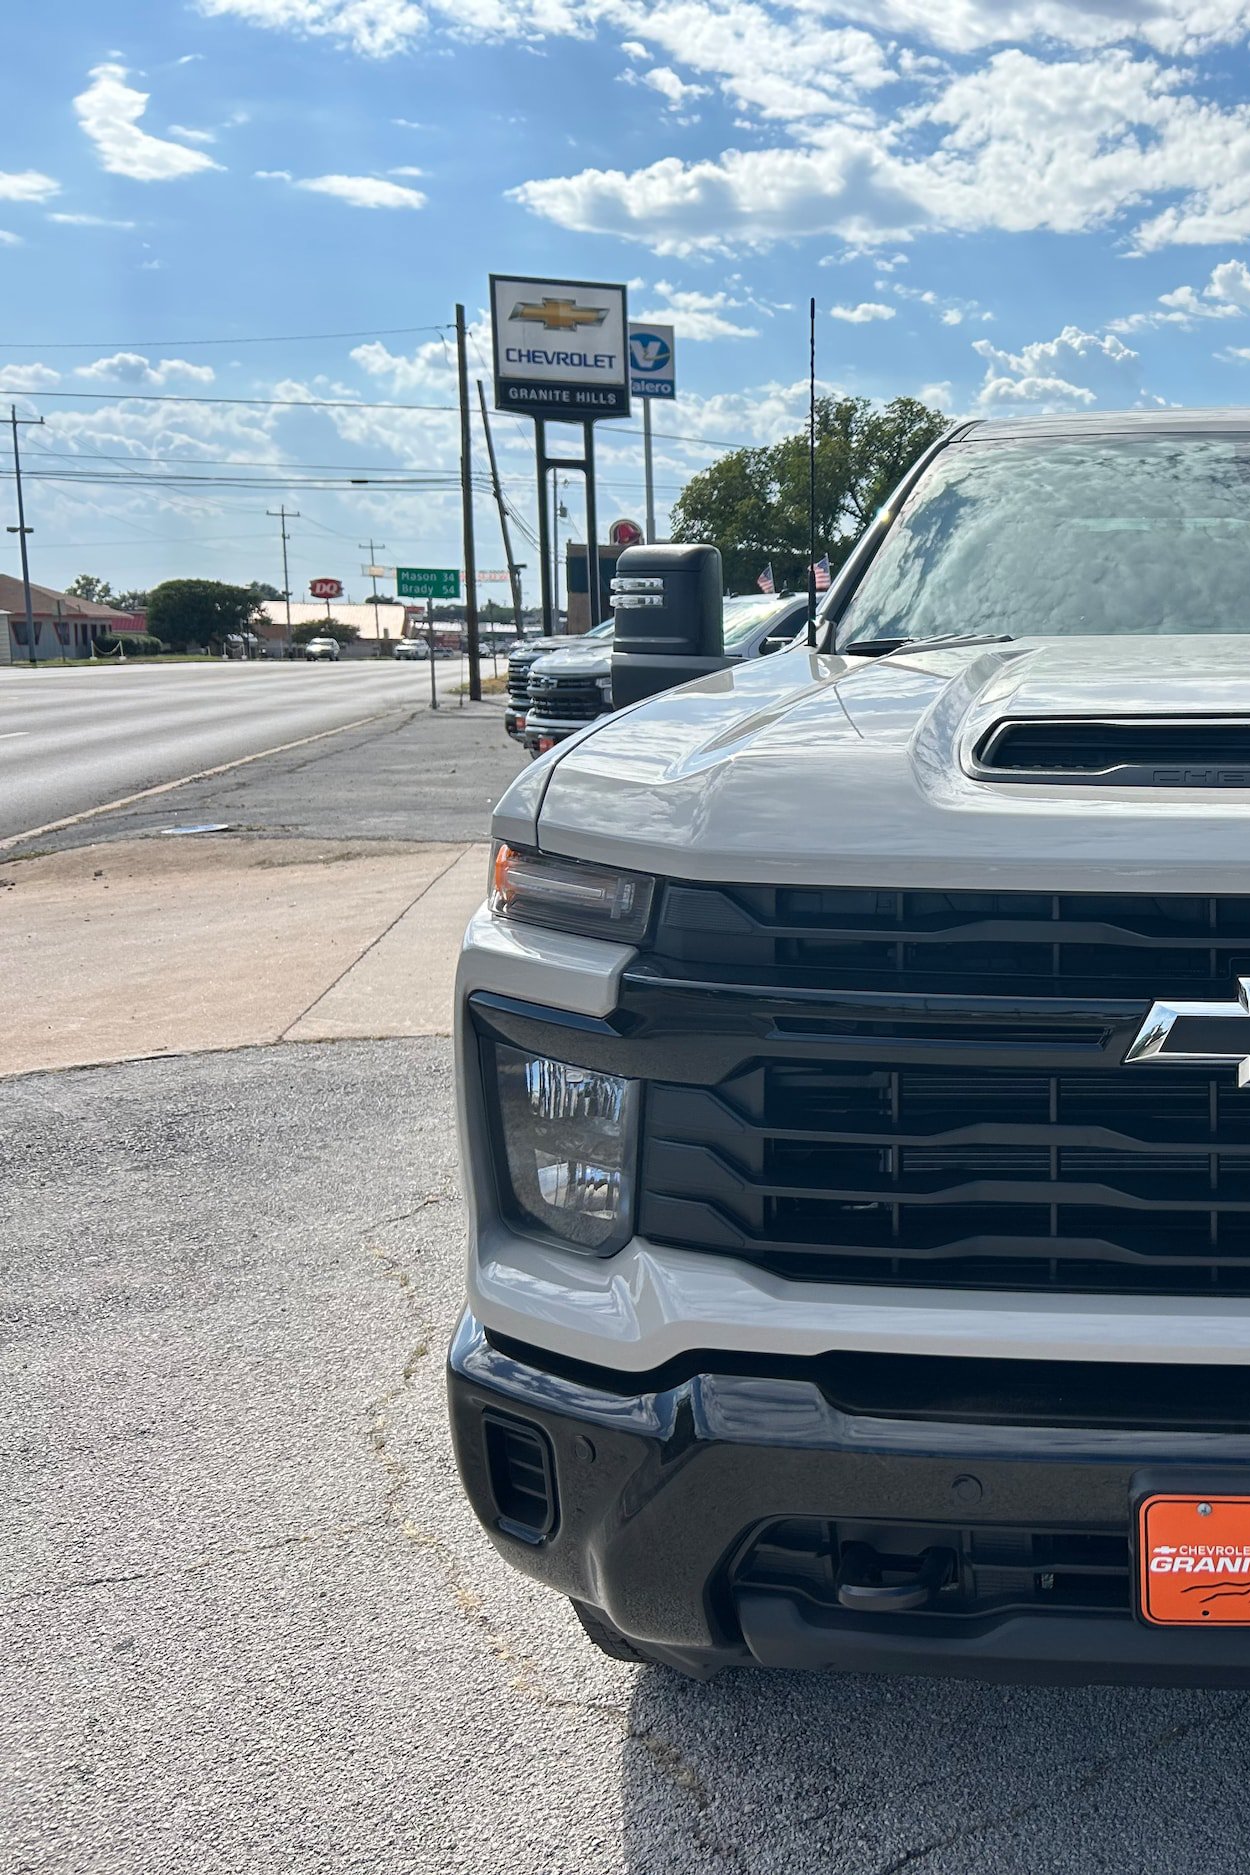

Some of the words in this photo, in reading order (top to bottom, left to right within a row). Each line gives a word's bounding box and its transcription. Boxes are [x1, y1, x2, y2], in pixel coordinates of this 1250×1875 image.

[505, 347, 616, 369] CHEVROLET
[630, 380, 672, 394] alero
[508, 386, 571, 402] GRANITE
[576, 390, 617, 405] HILLS
[401, 571, 437, 582] Mason
[442, 572, 455, 582] 34
[315, 582, 338, 595] DQ
[402, 584, 434, 595] Brady
[442, 585, 455, 594] 54
